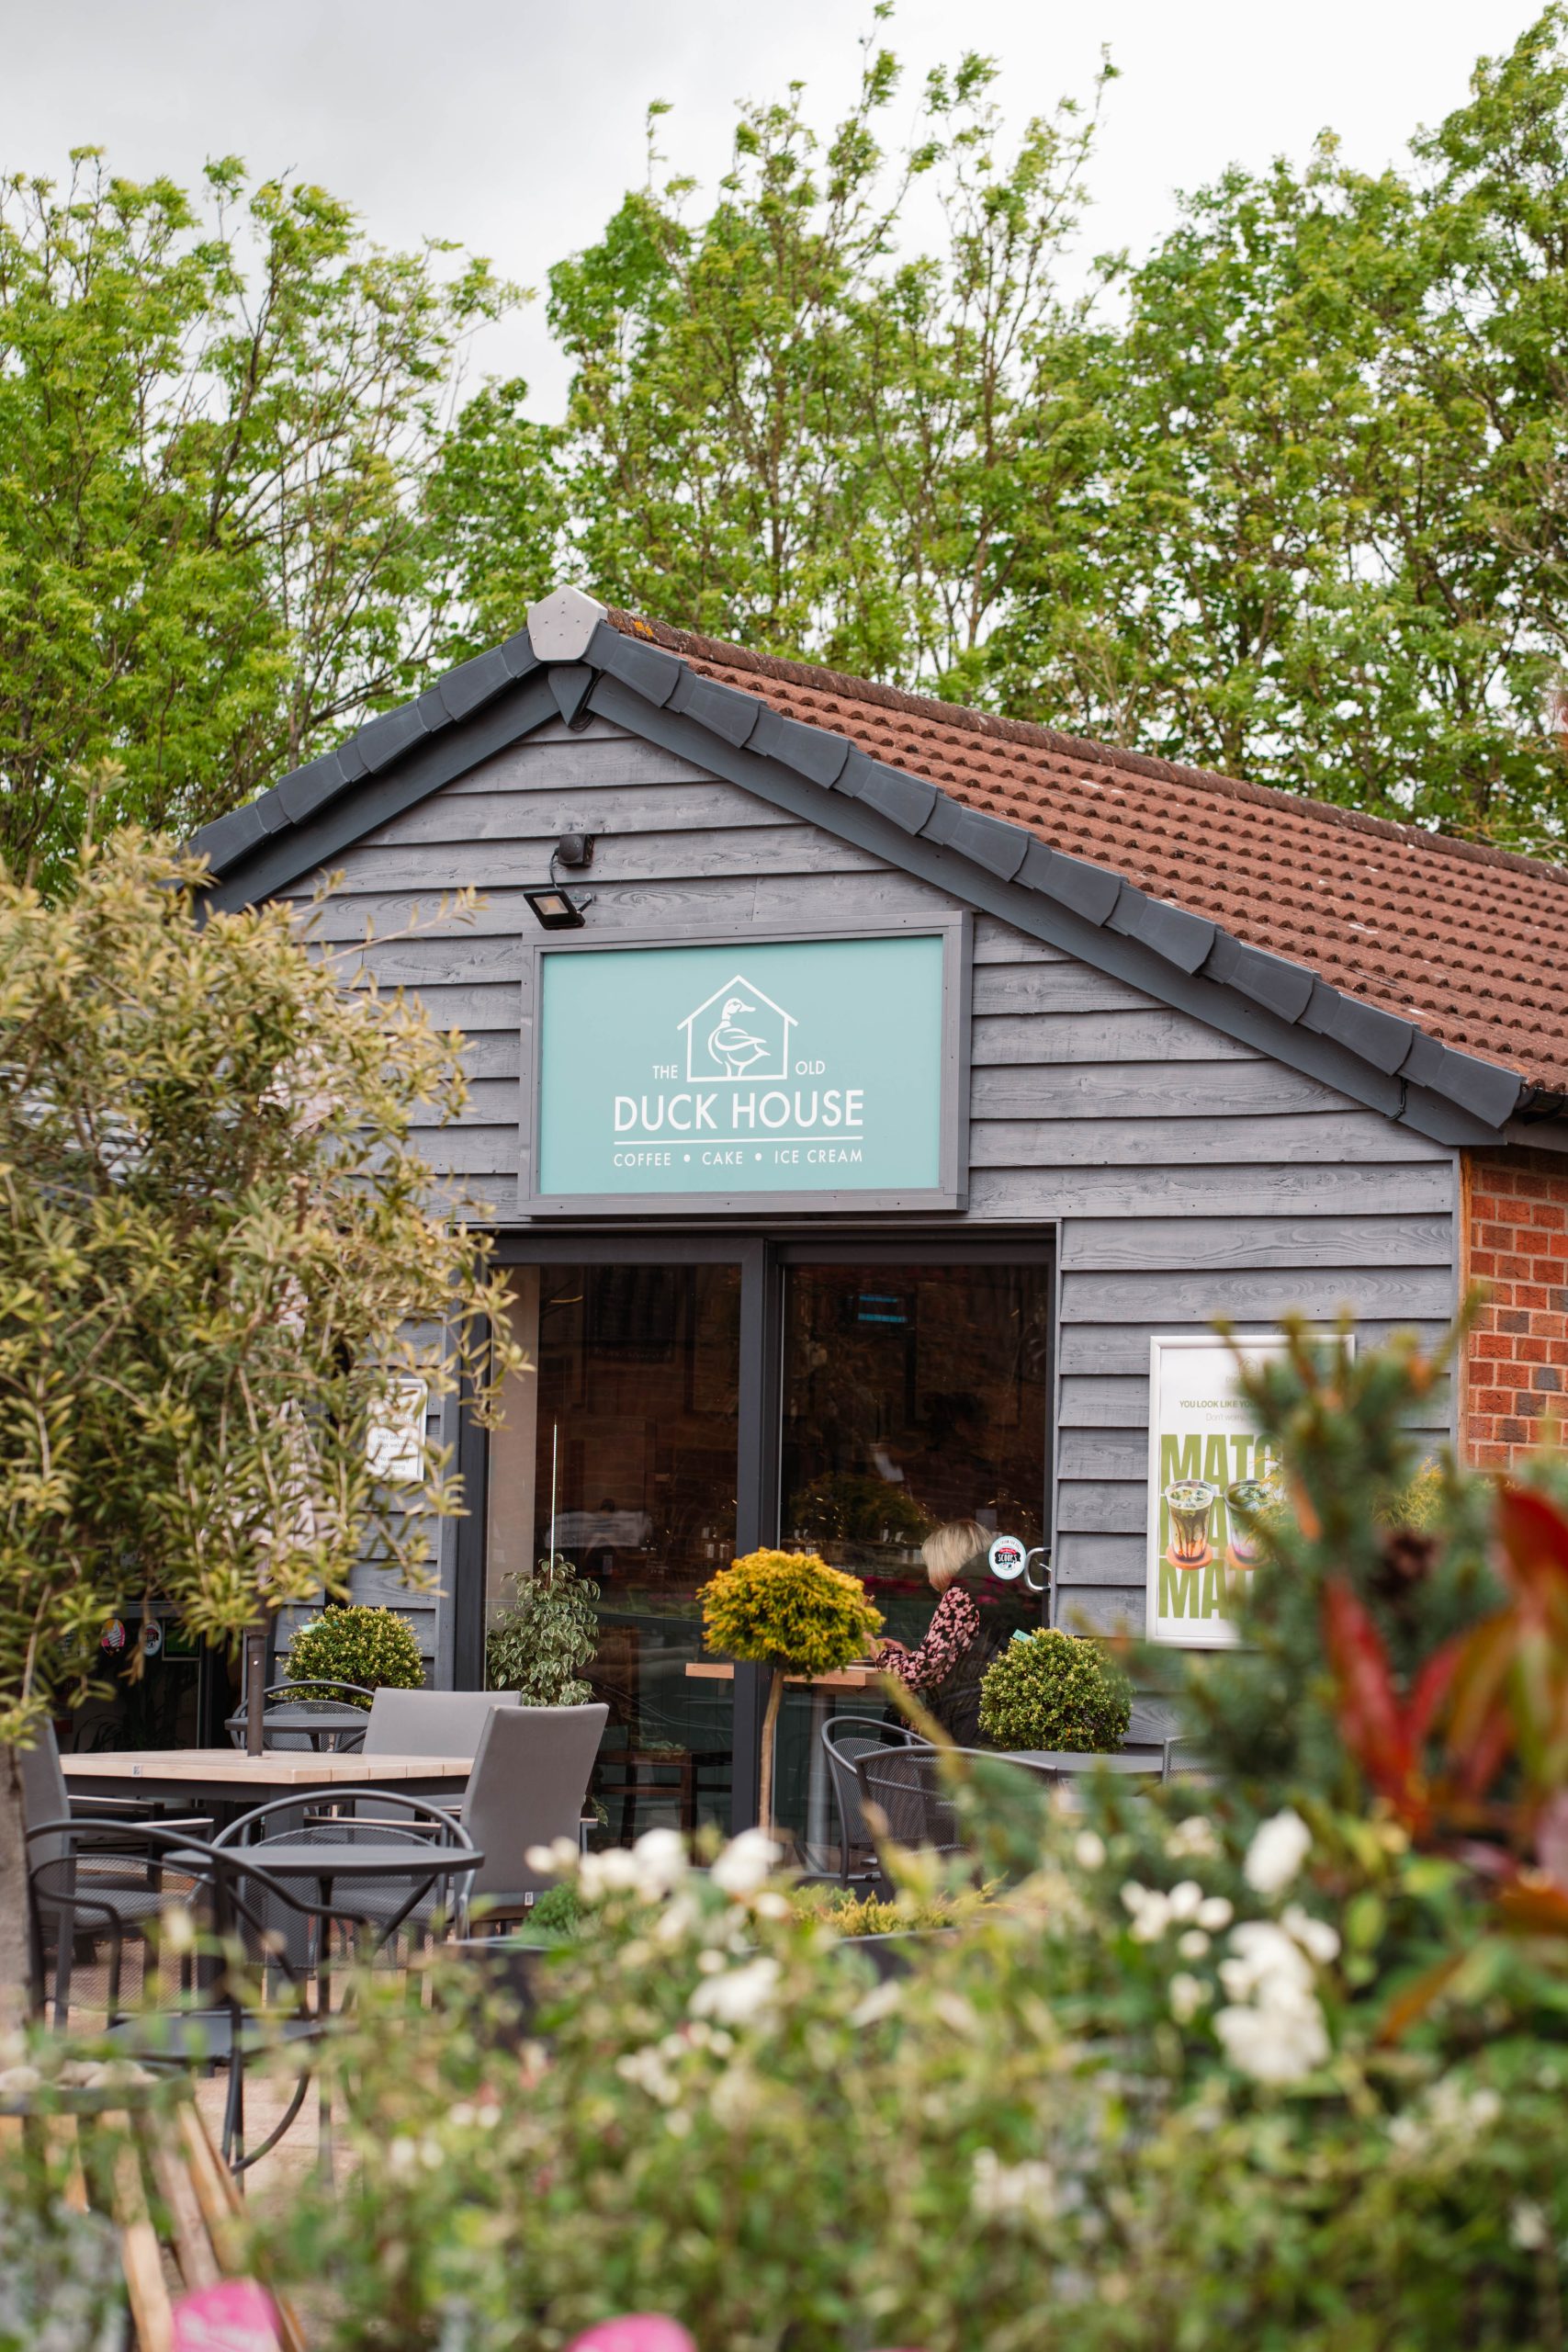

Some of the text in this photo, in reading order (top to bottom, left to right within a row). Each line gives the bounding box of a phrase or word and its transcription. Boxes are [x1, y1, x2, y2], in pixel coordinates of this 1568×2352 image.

[652, 1060, 825, 1080] THE OLD
[614, 1090, 863, 1131] DUCK HOUSE
[614, 1148, 863, 1167] COFFEE CAKE ICE CREAM
[1179, 1400, 1196, 1408] YOU
[1197, 1400, 1219, 1408] LOOK
[1220, 1400, 1238, 1408] LIKE
